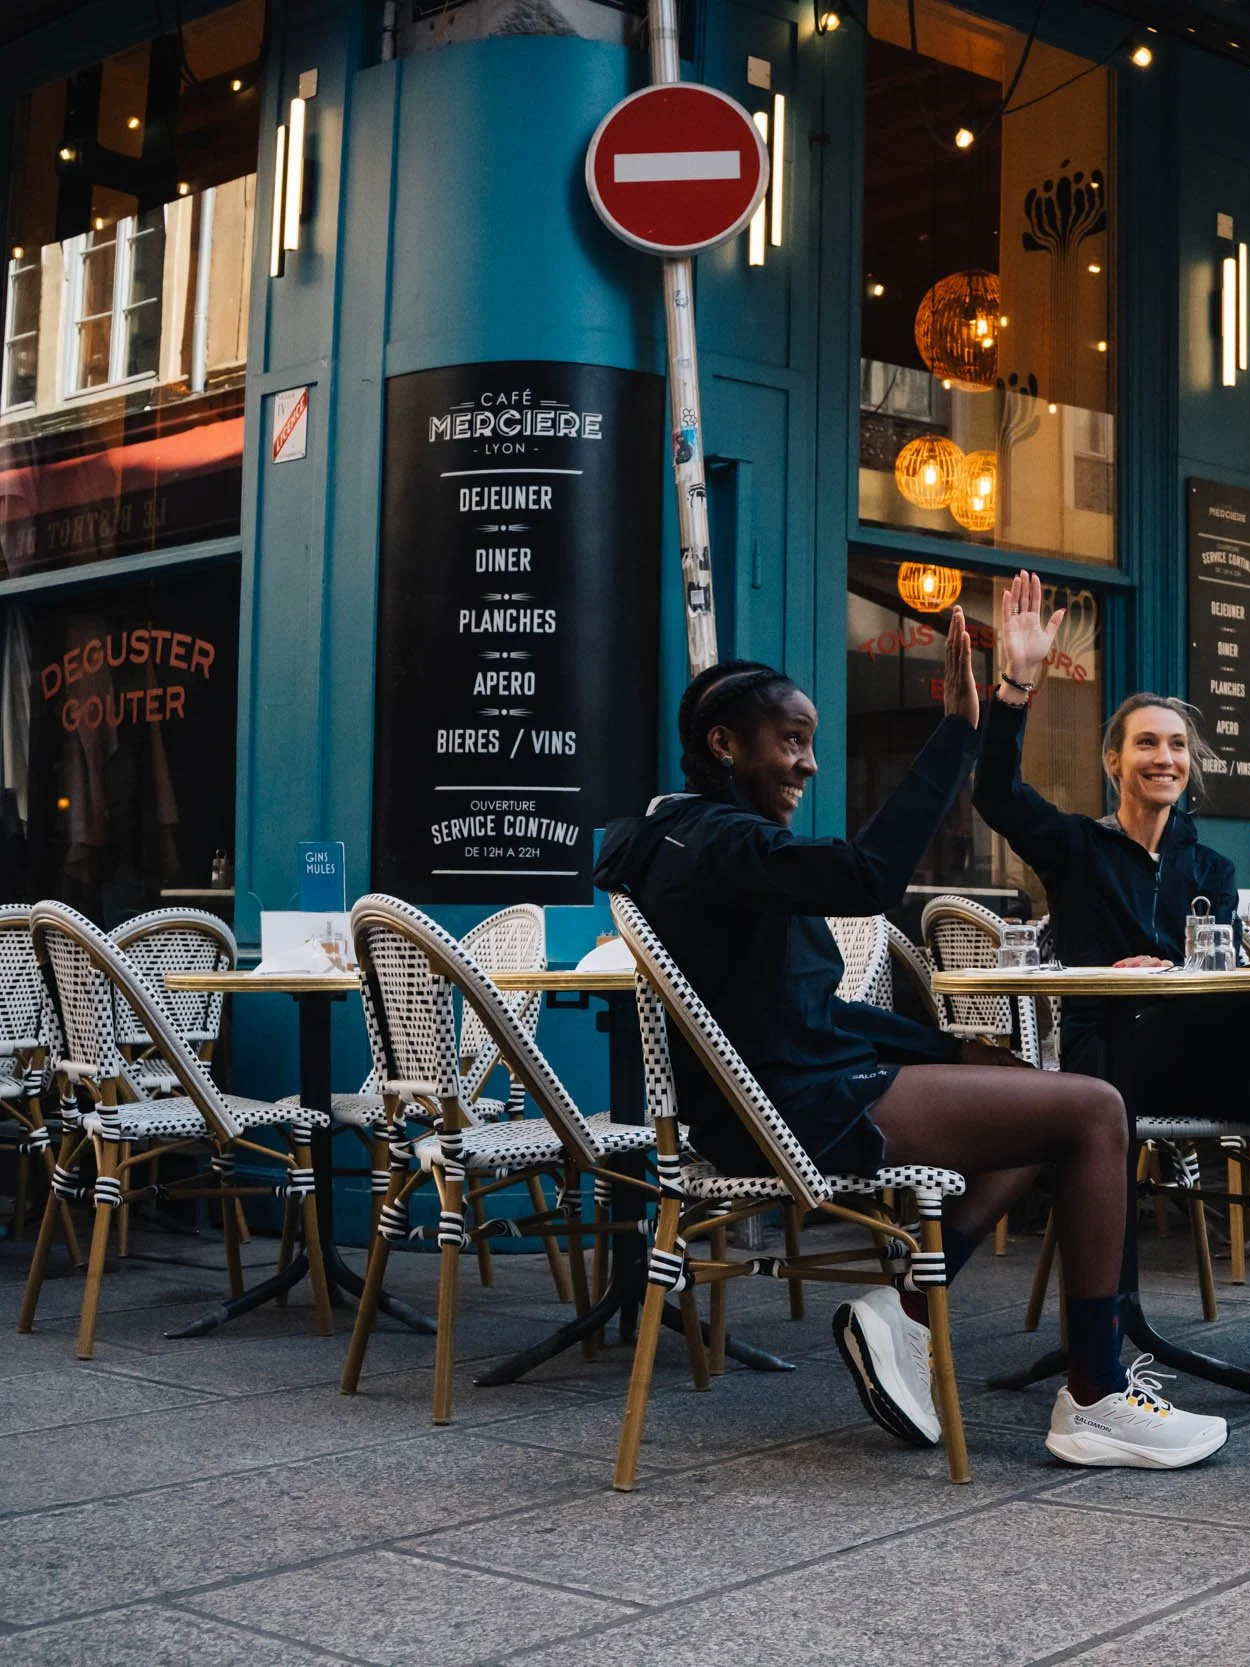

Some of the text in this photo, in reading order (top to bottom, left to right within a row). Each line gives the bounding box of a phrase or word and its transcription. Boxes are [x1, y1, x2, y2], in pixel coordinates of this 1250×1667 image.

[480, 388, 533, 407] CAFÉ
[428, 409, 603, 442] MERCIERE
[485, 442, 525, 455] LYON
[459, 485, 553, 512] DEJEUNER
[475, 547, 532, 572] DINER
[1201, 550, 1227, 565] SERVICE
[1211, 600, 1246, 620] DEJEUNER
[459, 608, 557, 633] PLANCHES
[857, 623, 935, 665] TOUS
[966, 624, 997, 649] ES
[1217, 641, 1240, 658] DINER
[40, 628, 216, 700] DEGUSTER
[472, 671, 537, 696] APERO
[1210, 679, 1246, 698] PLANCHES
[61, 685, 187, 743] GOUTER
[1216, 719, 1240, 737] APERO
[436, 728, 501, 754] BIERES
[531, 730, 578, 756] VINS
[1202, 758, 1228, 775] BIERES
[470, 799, 537, 812] OUVERTURE
[431, 814, 581, 847] SERVICE CONTINU
[305, 851, 328, 863] GINS
[464, 846, 480, 858] DE
[483, 846, 503, 858] 12H
[518, 846, 541, 858] 22H
[306, 863, 336, 875] MULES
[1073, 1414, 1112, 1432] SALOMON
